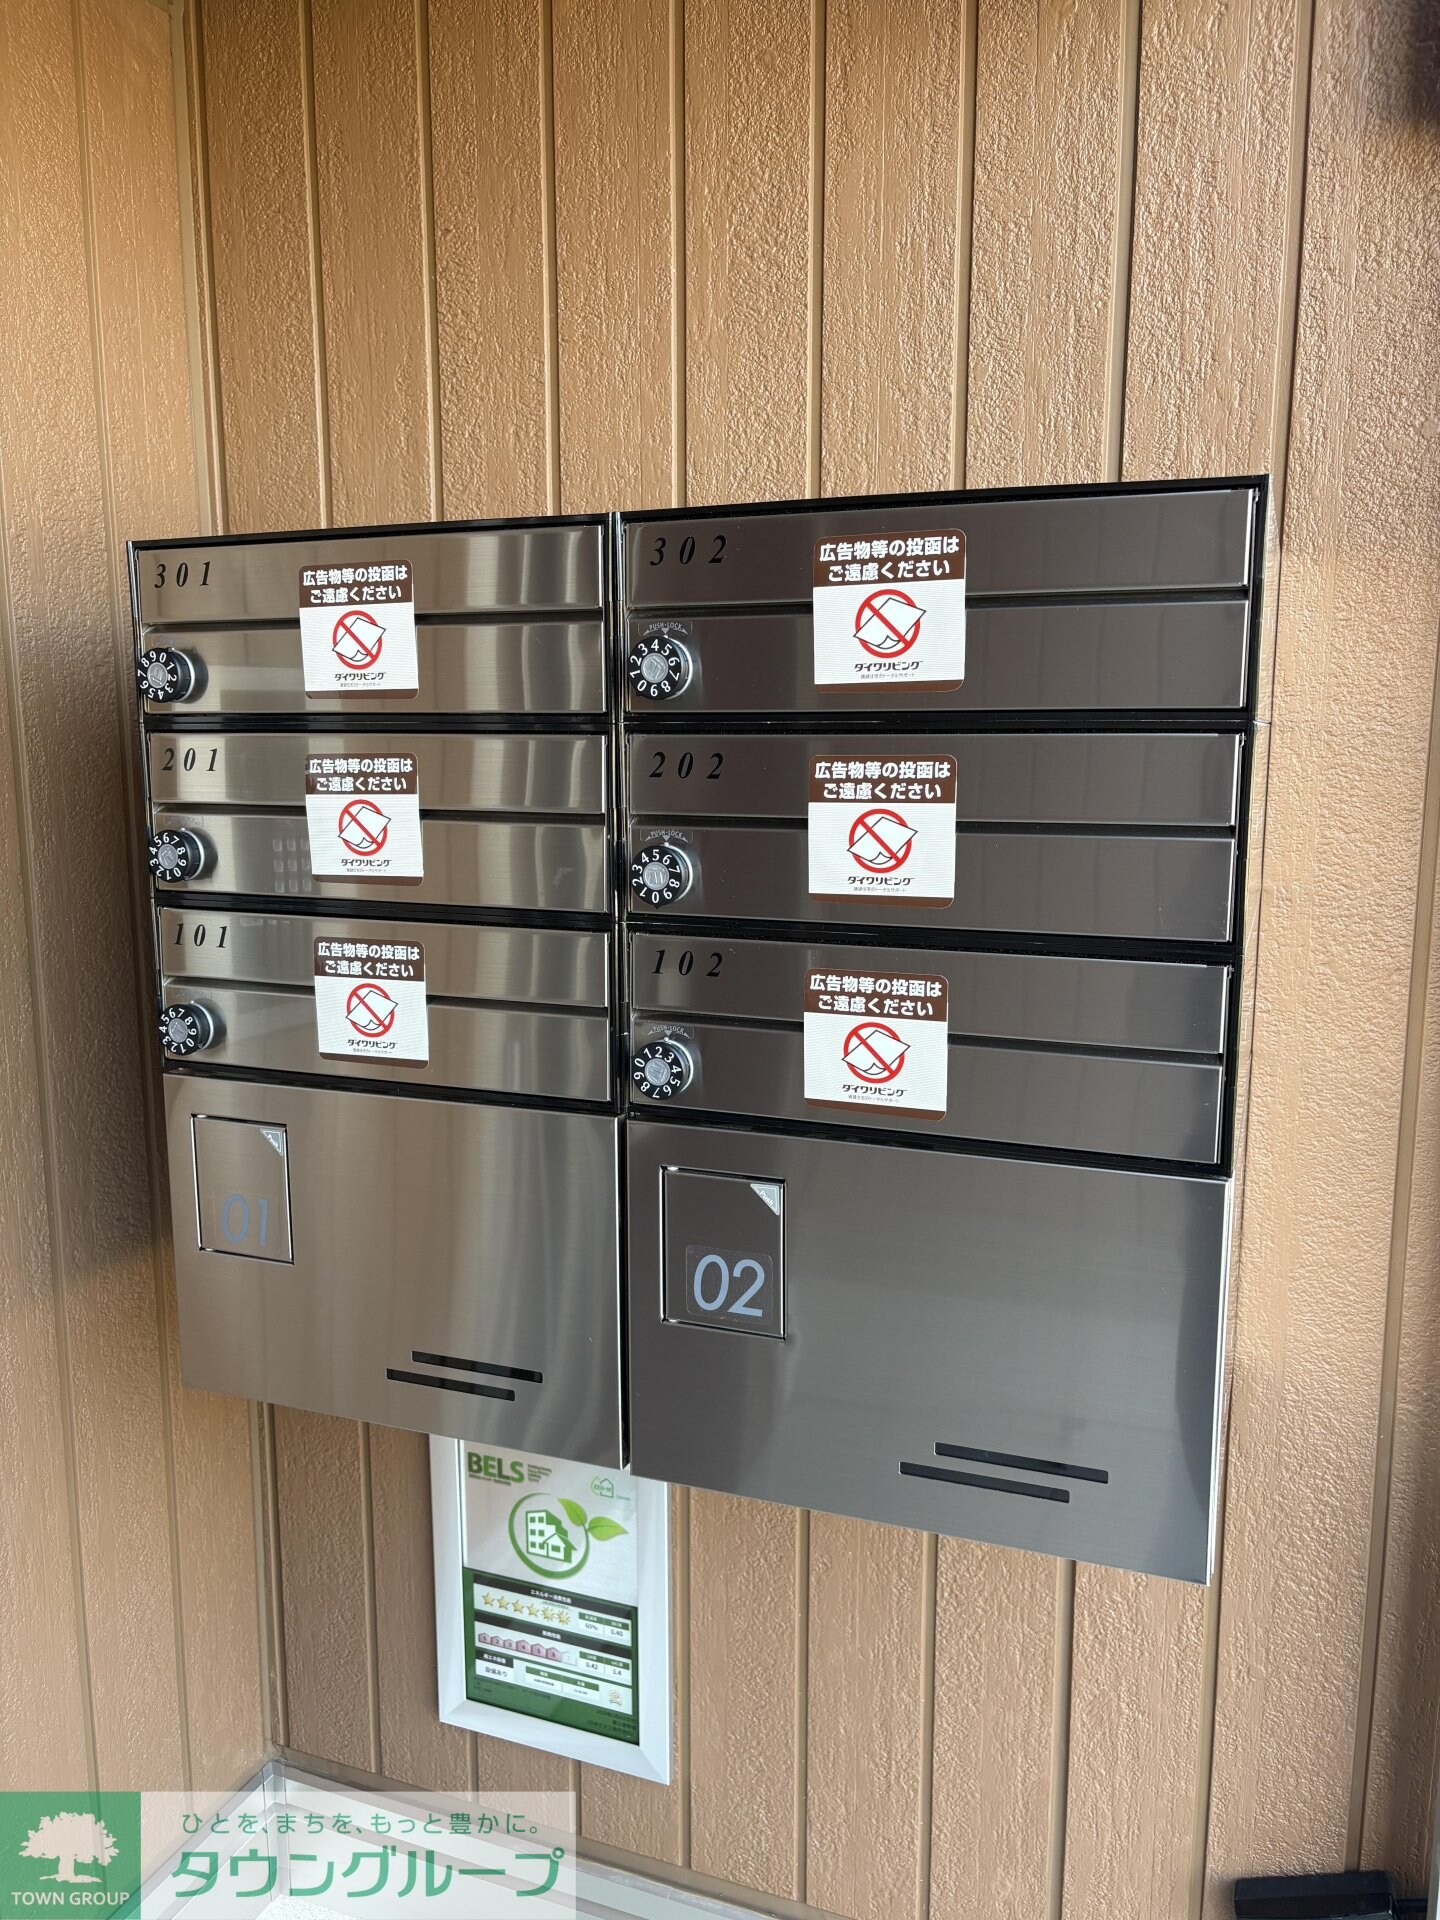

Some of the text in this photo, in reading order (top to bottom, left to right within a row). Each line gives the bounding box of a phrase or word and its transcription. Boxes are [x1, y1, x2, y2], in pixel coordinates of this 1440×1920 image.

[650, 535, 727, 566] 302
[820, 535, 959, 561] 広告物等の投函は
[155, 561, 211, 588] 301
[303, 565, 408, 586] 広告物等の投函は
[828, 560, 950, 582] ご遠慮ください
[310, 585, 401, 604] ご遠慮ください
[854, 660, 923, 672] ダイワリビング
[335, 672, 386, 682] ダイワリビング
[162, 748, 218, 772] 201
[310, 758, 413, 774] 広告物等の投函は
[649, 751, 724, 779] 202
[814, 761, 951, 779] 広告物等の投函は
[316, 777, 406, 791] ご遠慮ください
[823, 782, 941, 799] ご遠慮ください
[341, 859, 392, 867] ダイワリビング
[847, 876, 915, 886] ダイワリビング
[173, 923, 228, 948] 101
[318, 941, 420, 960] 広告物等の投函は
[325, 959, 414, 977] ご遠慮ください
[652, 949, 723, 977] 102
[810, 974, 942, 997] 広告物等の投函は
[818, 994, 934, 1016] ご遠慮ください
[348, 1039, 398, 1050] ダイワリビング
[842, 1083, 907, 1096] ダイワリビング
[760, 1190, 774, 1206] Push
[222, 1193, 269, 1248] 01
[693, 1254, 765, 1317] 02
[467, 1451, 525, 1483] BELS
